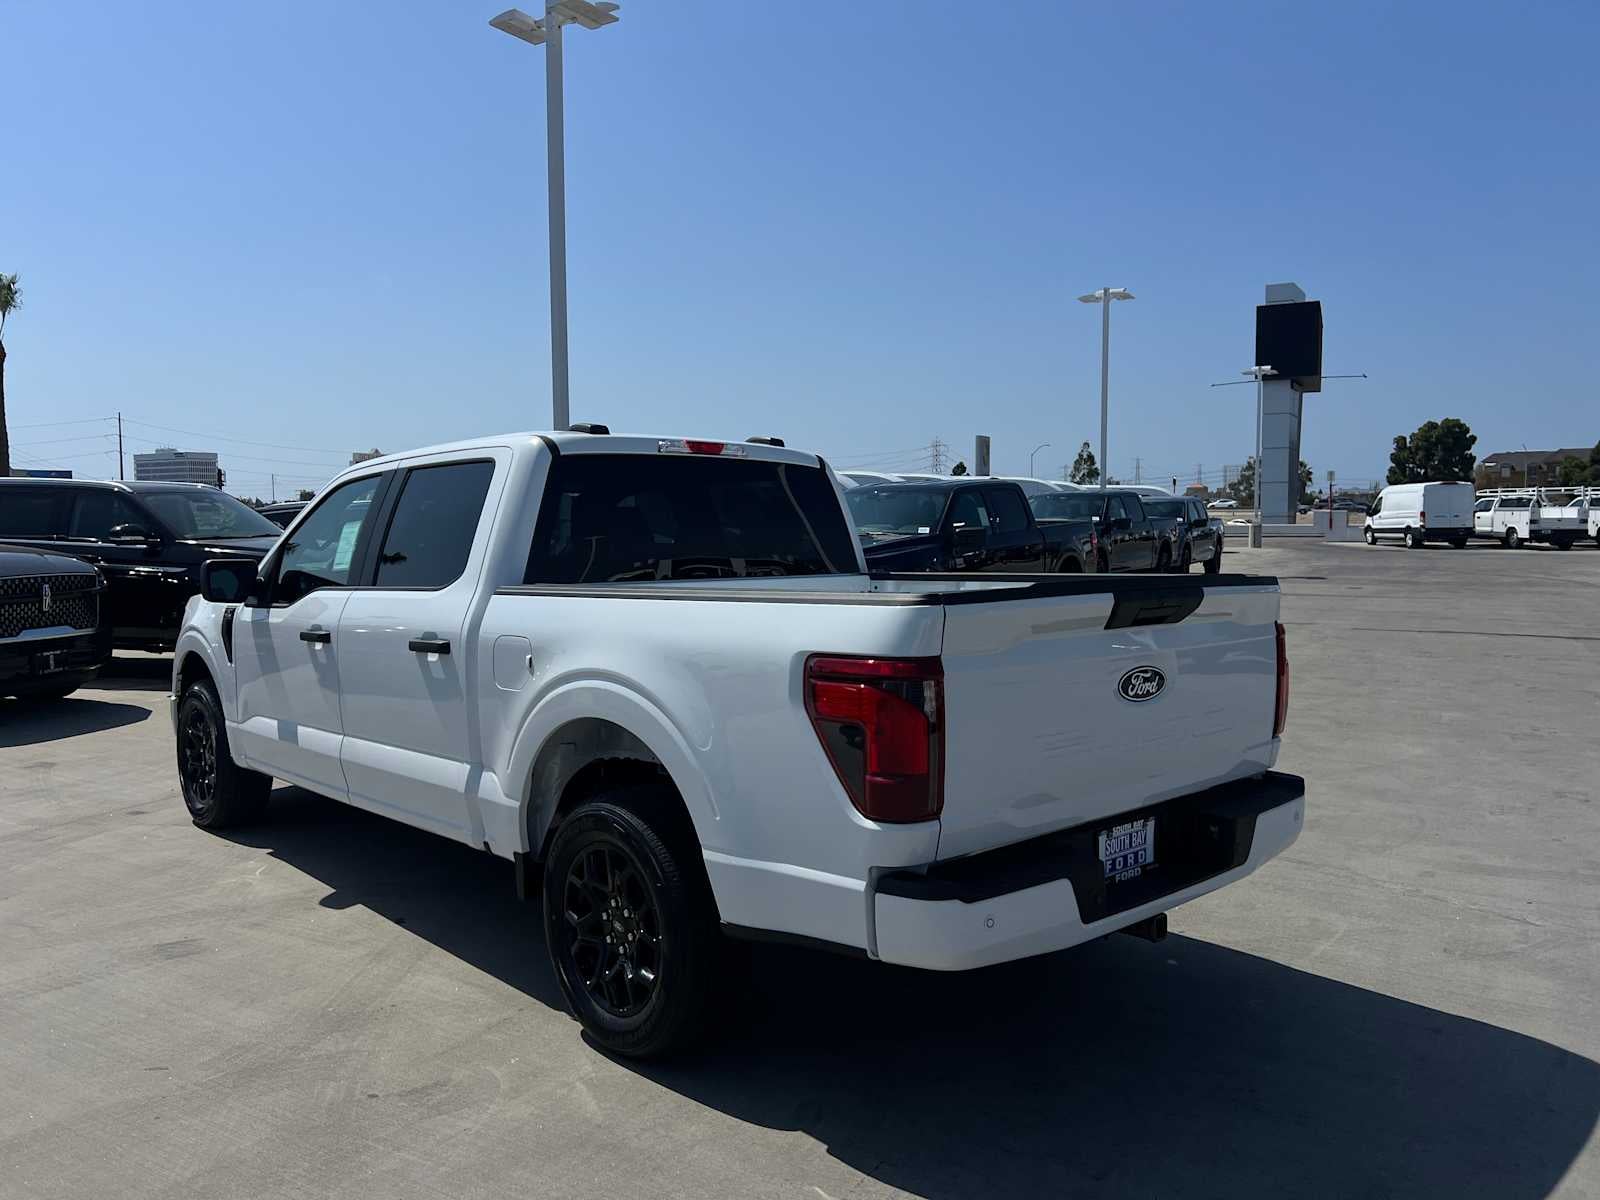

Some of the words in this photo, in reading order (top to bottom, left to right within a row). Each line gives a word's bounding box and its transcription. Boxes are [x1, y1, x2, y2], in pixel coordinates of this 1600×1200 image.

[1127, 672, 1160, 697] Ford
[1105, 834, 1130, 855] SOUTH
[1131, 830, 1146, 847] BAY
[1105, 850, 1145, 873] FORD
[1115, 866, 1142, 884] FORD
